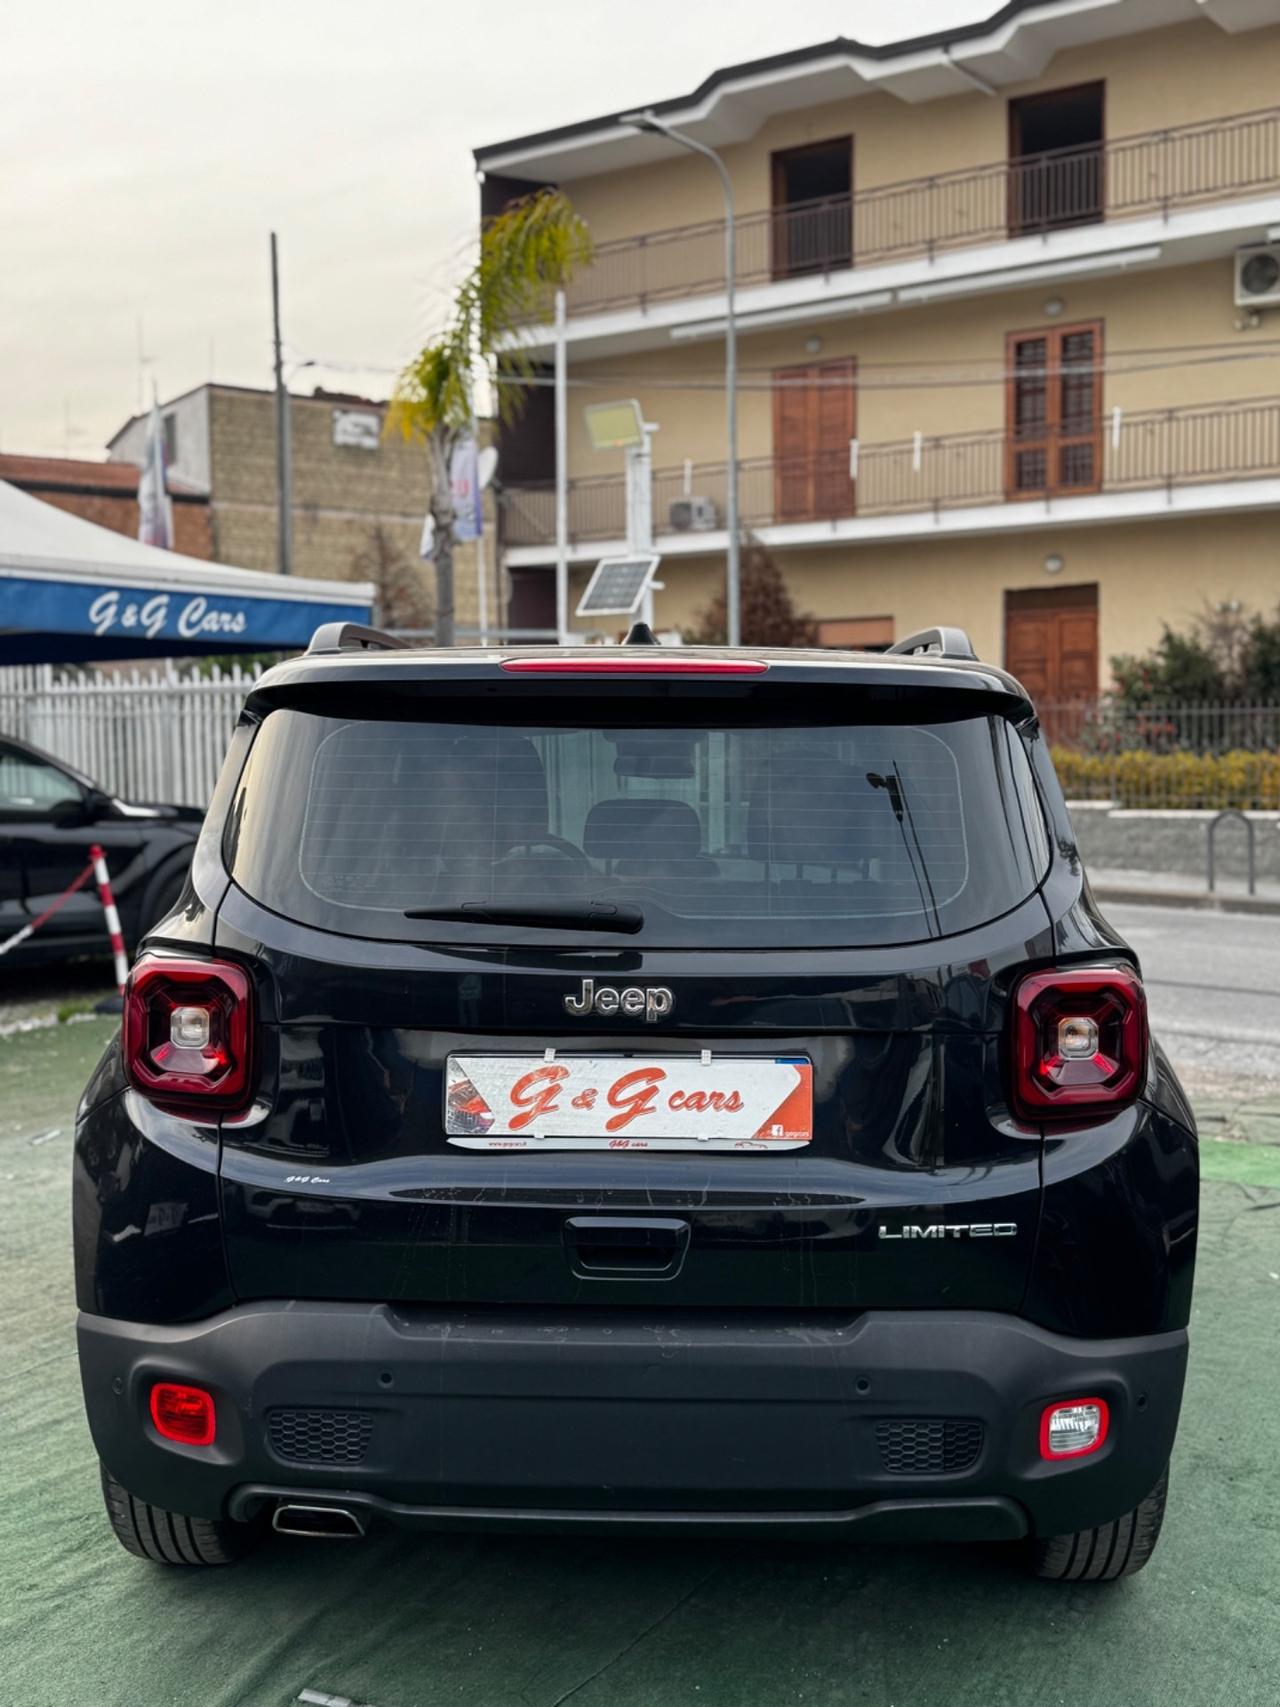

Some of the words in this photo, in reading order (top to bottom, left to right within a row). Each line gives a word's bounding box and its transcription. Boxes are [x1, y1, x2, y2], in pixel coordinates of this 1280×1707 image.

[177, 596, 247, 638] Cars
[565, 979, 673, 1021] Jeep
[668, 1090, 744, 1113] cars
[878, 1223, 1018, 1239] LIMITED
